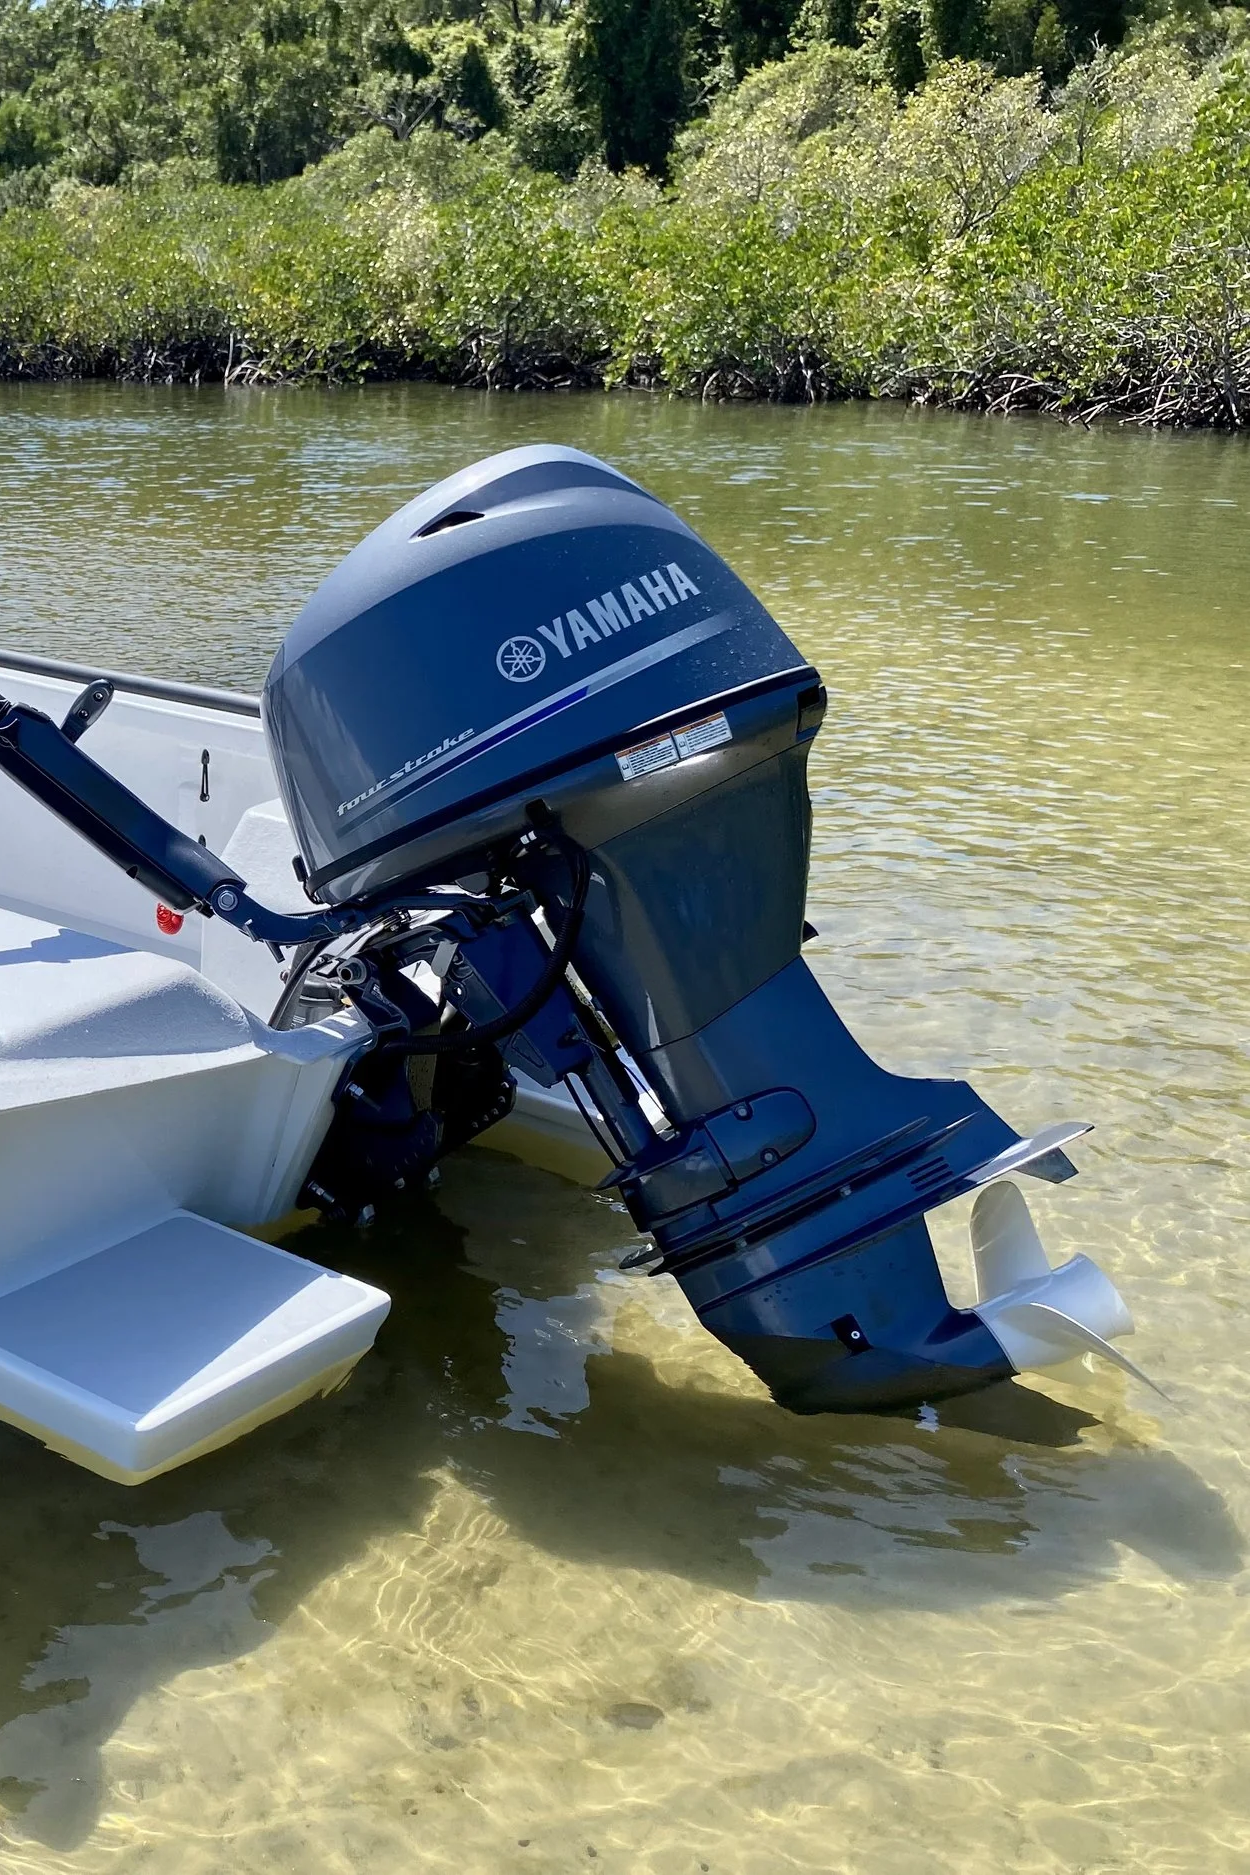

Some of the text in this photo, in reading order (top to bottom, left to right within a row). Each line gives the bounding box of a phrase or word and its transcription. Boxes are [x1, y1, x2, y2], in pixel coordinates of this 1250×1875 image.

[537, 562, 701, 659] YAMAHA
[337, 728, 475, 817] four stroke
